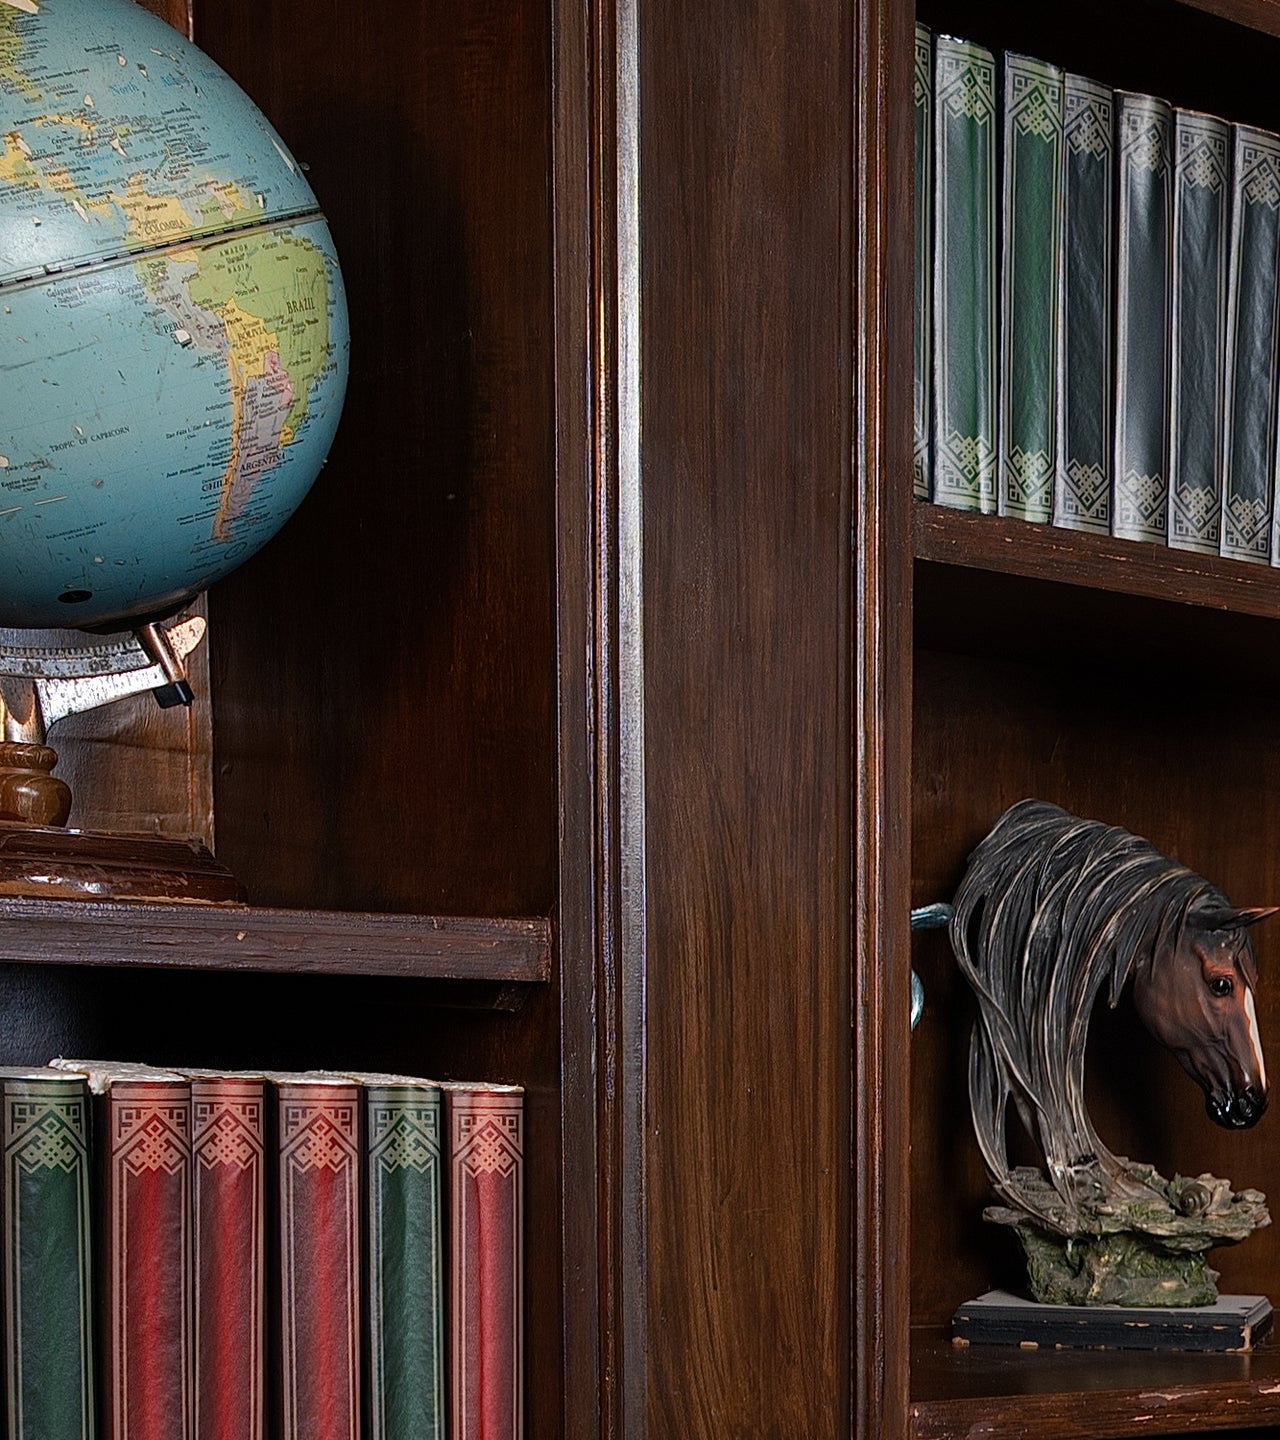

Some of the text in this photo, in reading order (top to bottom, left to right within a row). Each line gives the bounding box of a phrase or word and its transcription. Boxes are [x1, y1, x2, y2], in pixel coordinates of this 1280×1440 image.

[144, 219, 186, 235] COLOMBIA
[219, 244, 249, 257] AMAZON
[286, 297, 316, 314] BRAZIL
[163, 320, 186, 334] PERU
[49, 426, 130, 453] TROPIC OF CAPRICORN
[240, 451, 286, 471] ARGENTINA
[202, 478, 231, 492] CHILE
